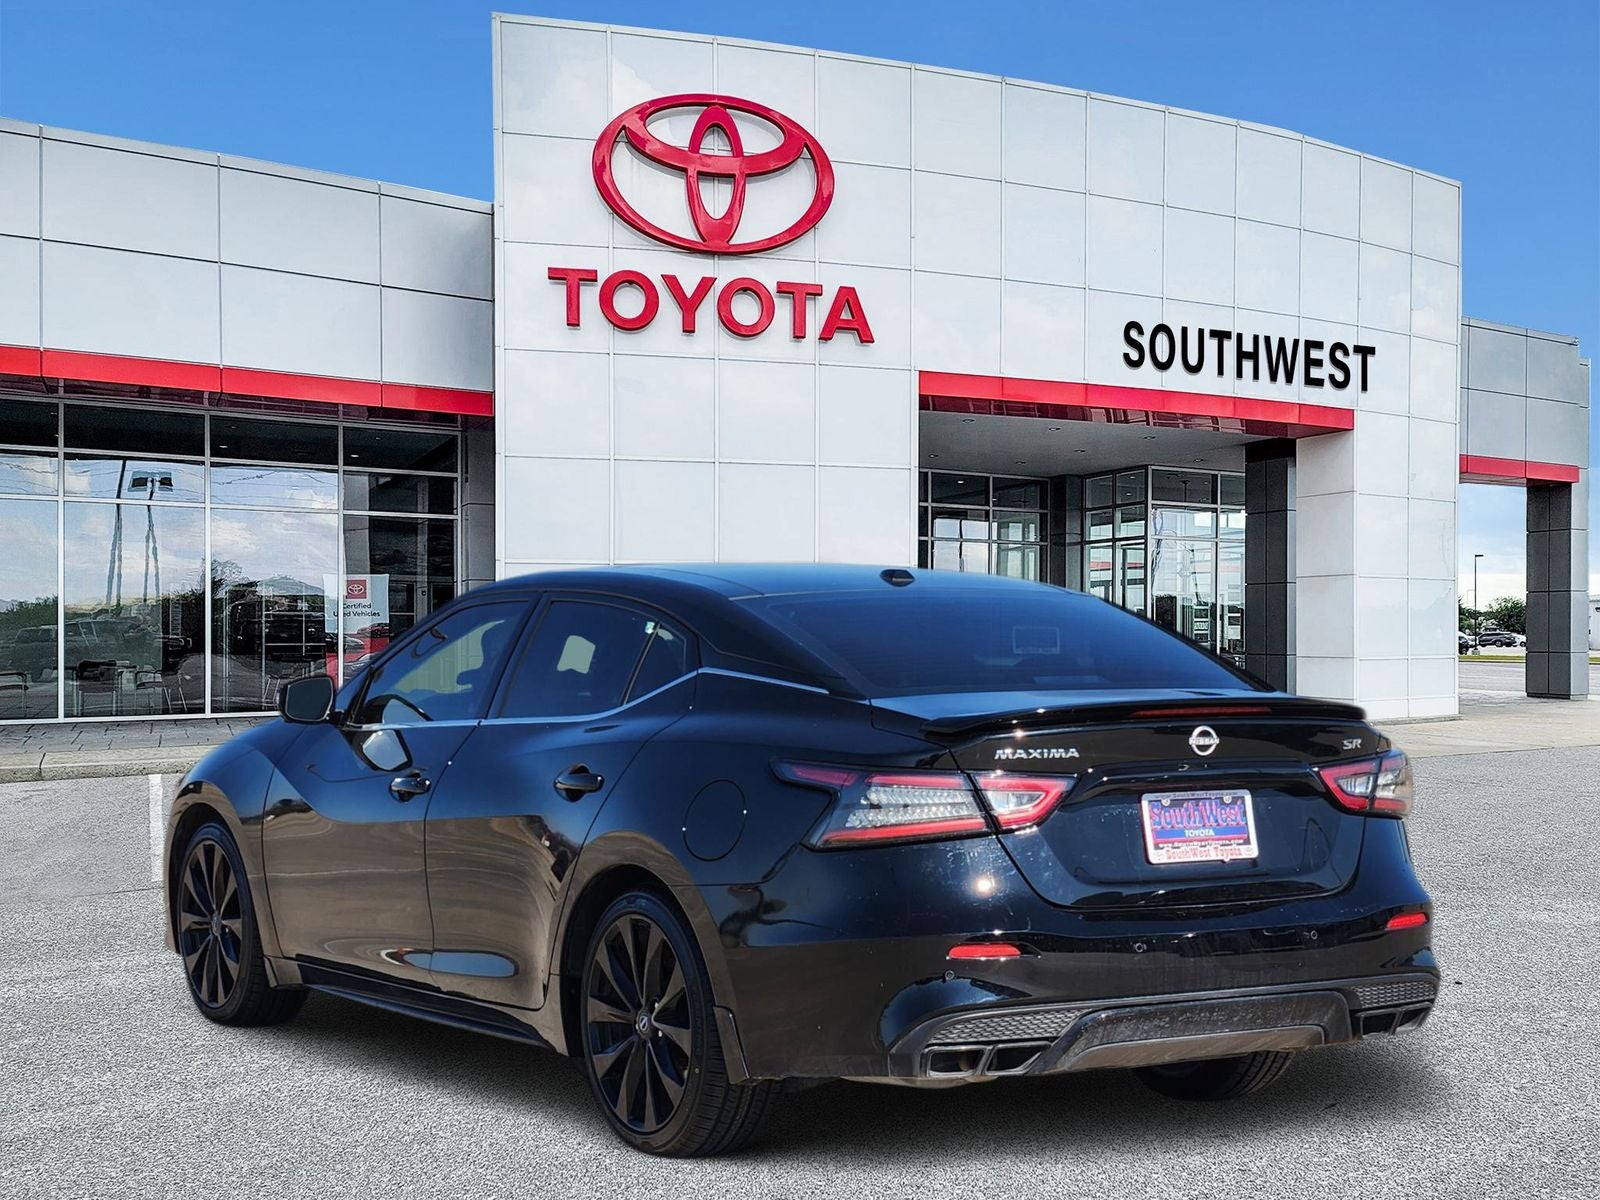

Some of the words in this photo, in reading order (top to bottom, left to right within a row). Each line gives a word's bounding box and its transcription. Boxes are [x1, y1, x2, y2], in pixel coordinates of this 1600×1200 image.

[547, 266, 875, 344] TOYOTA
[1122, 320, 1376, 393] SOUTHWEST
[1188, 736, 1220, 746] NISSAN
[1342, 738, 1362, 750] SR
[993, 748, 1081, 760] MAXIMA
[1184, 828, 1216, 838] TOYOTA
[1213, 845, 1243, 859] Toyota
